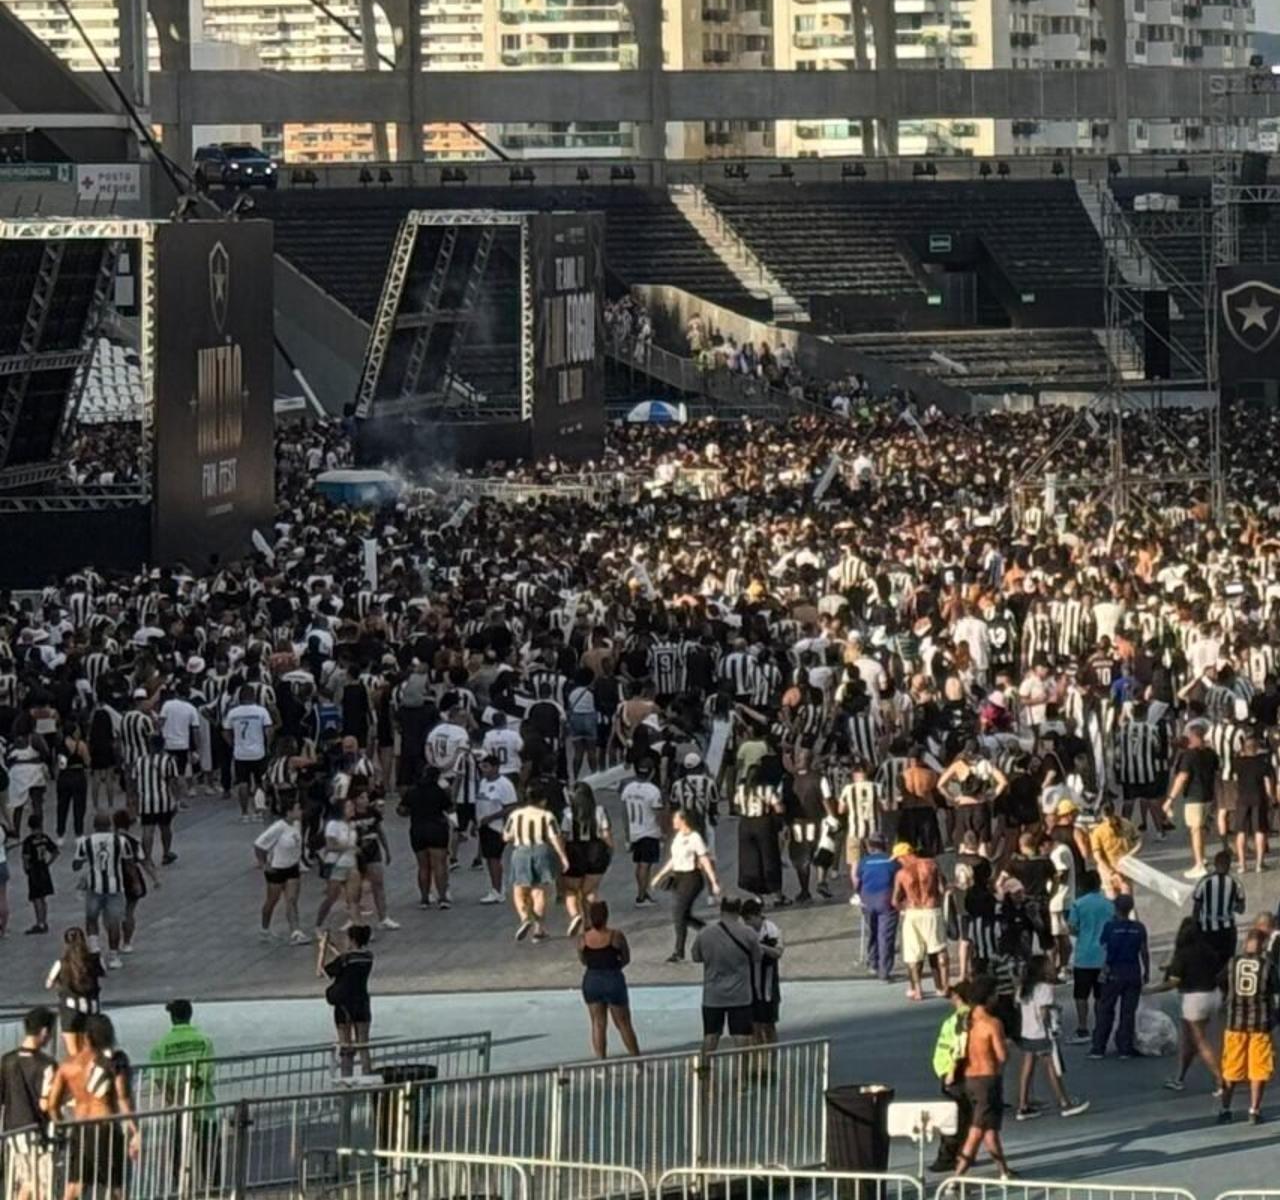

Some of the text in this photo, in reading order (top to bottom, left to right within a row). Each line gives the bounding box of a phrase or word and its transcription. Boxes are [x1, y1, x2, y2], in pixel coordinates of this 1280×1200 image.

[1095, 666, 1111, 687] 10
[240, 721, 249, 741] 7
[630, 801, 644, 825] 11
[1236, 959, 1259, 997] 6
